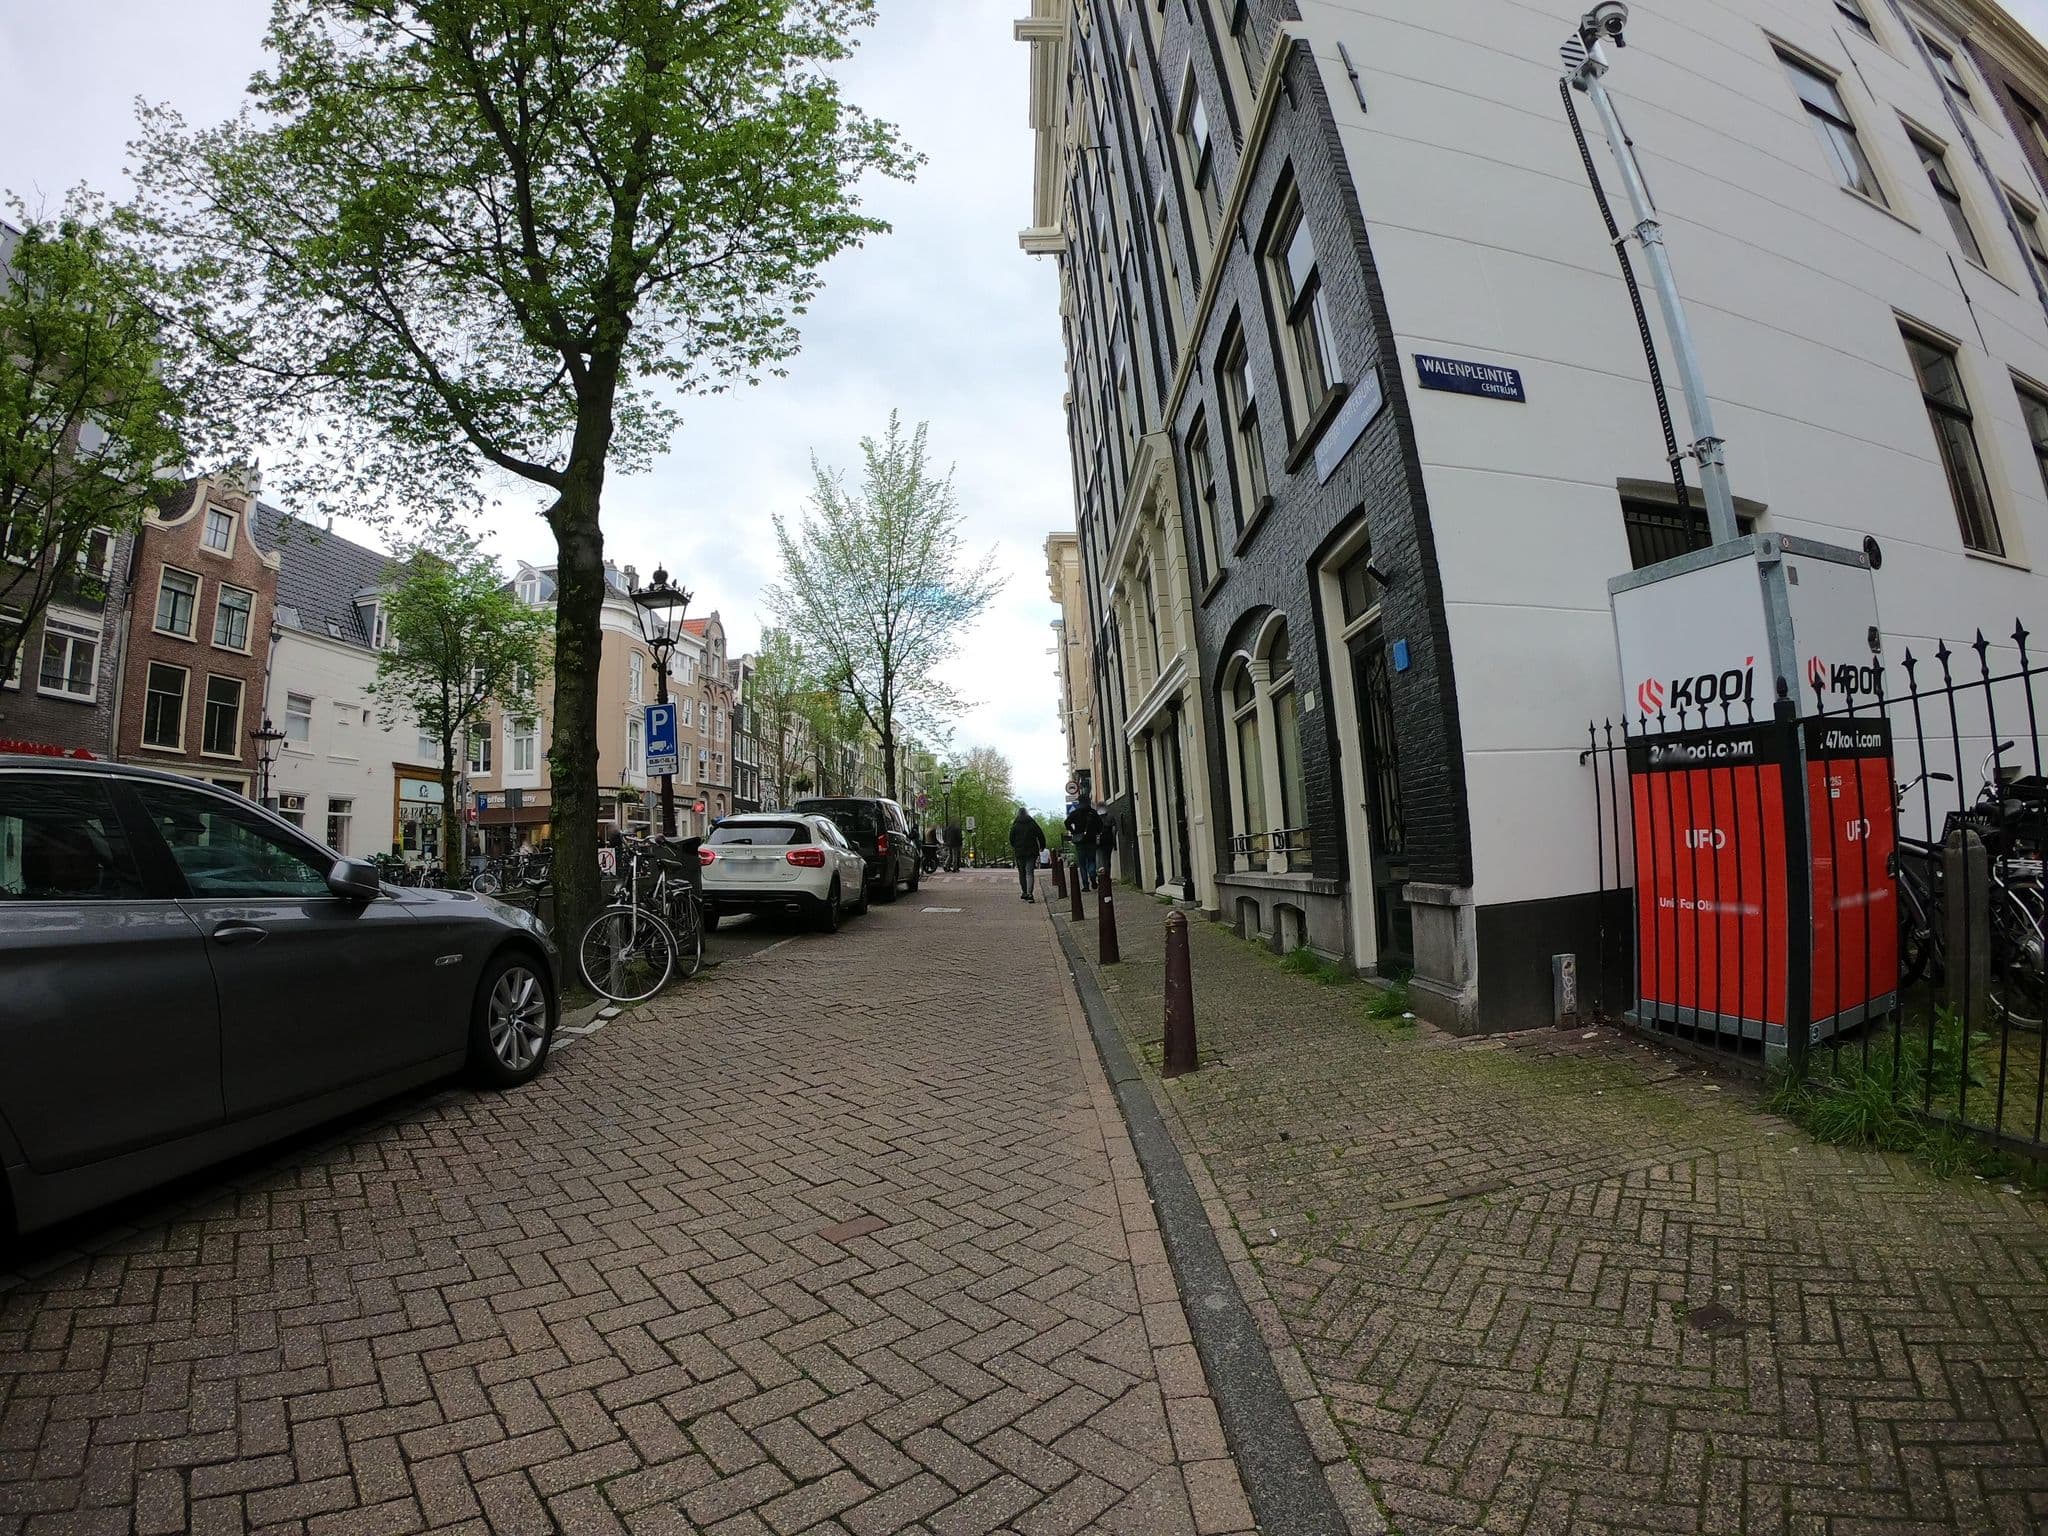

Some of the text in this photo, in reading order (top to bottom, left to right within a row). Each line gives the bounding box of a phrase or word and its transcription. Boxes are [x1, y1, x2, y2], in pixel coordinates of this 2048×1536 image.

[1421, 358, 1515, 386] WALENPLEINTJE
[1481, 383, 1518, 396] CENTRUM
[651, 709, 669, 736] P
[1685, 829, 1726, 850] UFO
[1659, 897, 1675, 908] Uni
